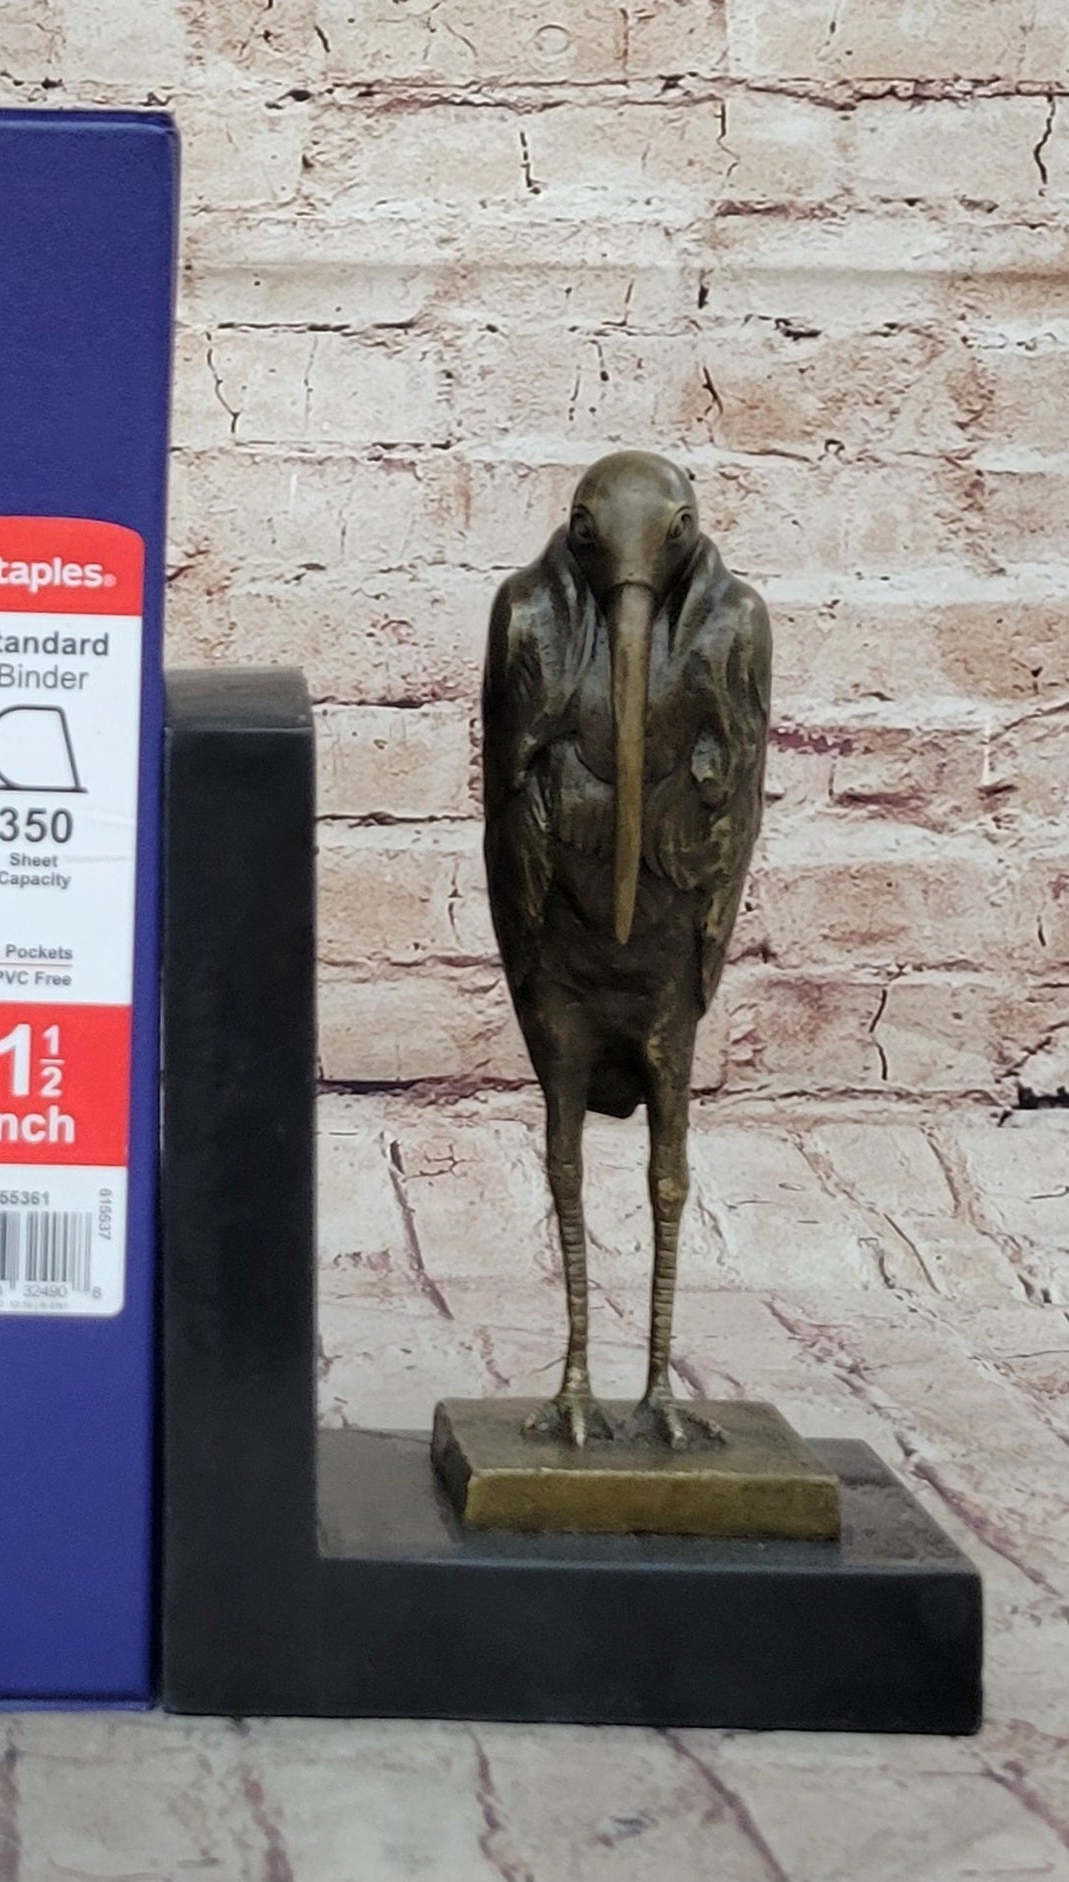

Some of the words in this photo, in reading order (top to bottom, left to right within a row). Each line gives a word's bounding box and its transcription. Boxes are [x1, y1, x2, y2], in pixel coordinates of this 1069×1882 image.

[9, 852, 58, 868] Sheet
[5, 944, 73, 960] Pockets
[34, 971, 72, 986] Free
